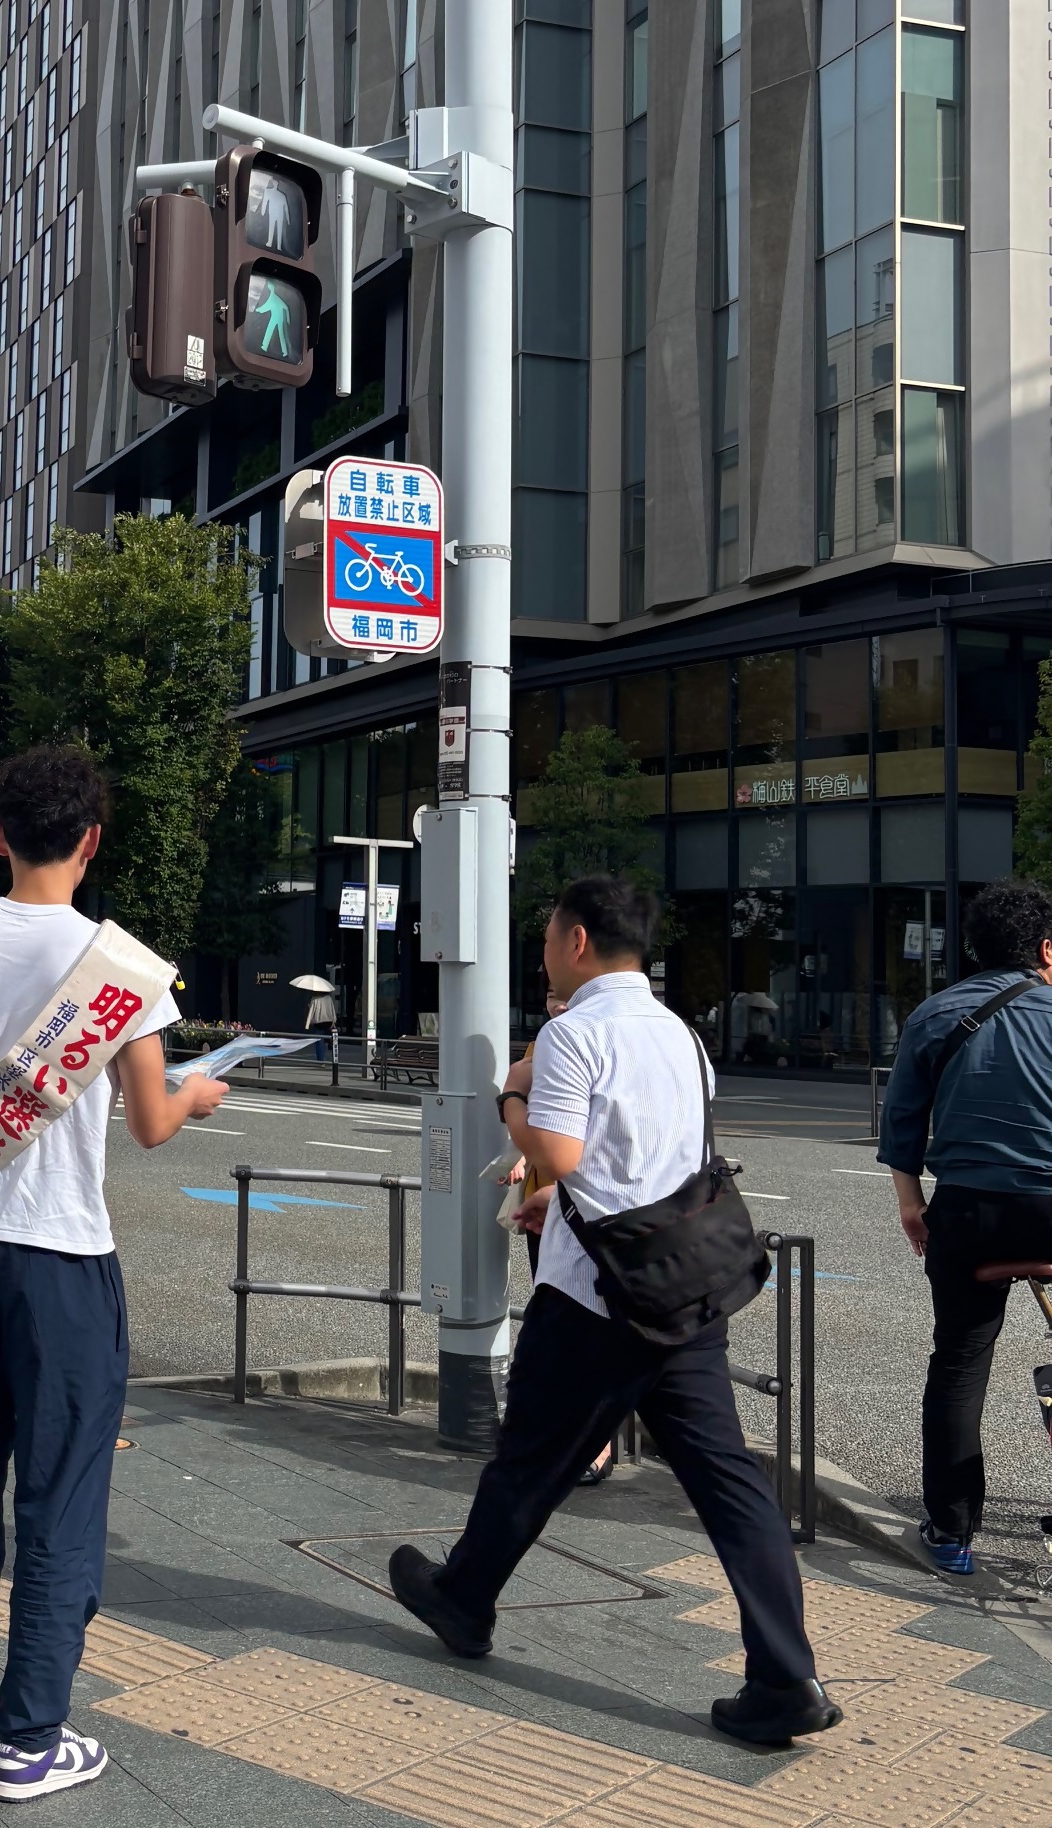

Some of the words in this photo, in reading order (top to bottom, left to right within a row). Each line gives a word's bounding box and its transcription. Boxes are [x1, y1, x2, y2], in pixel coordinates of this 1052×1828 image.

[349, 469, 421, 498] 自転車
[337, 493, 432, 526] 放置禁止区域
[351, 614, 418, 643] 福岡市
